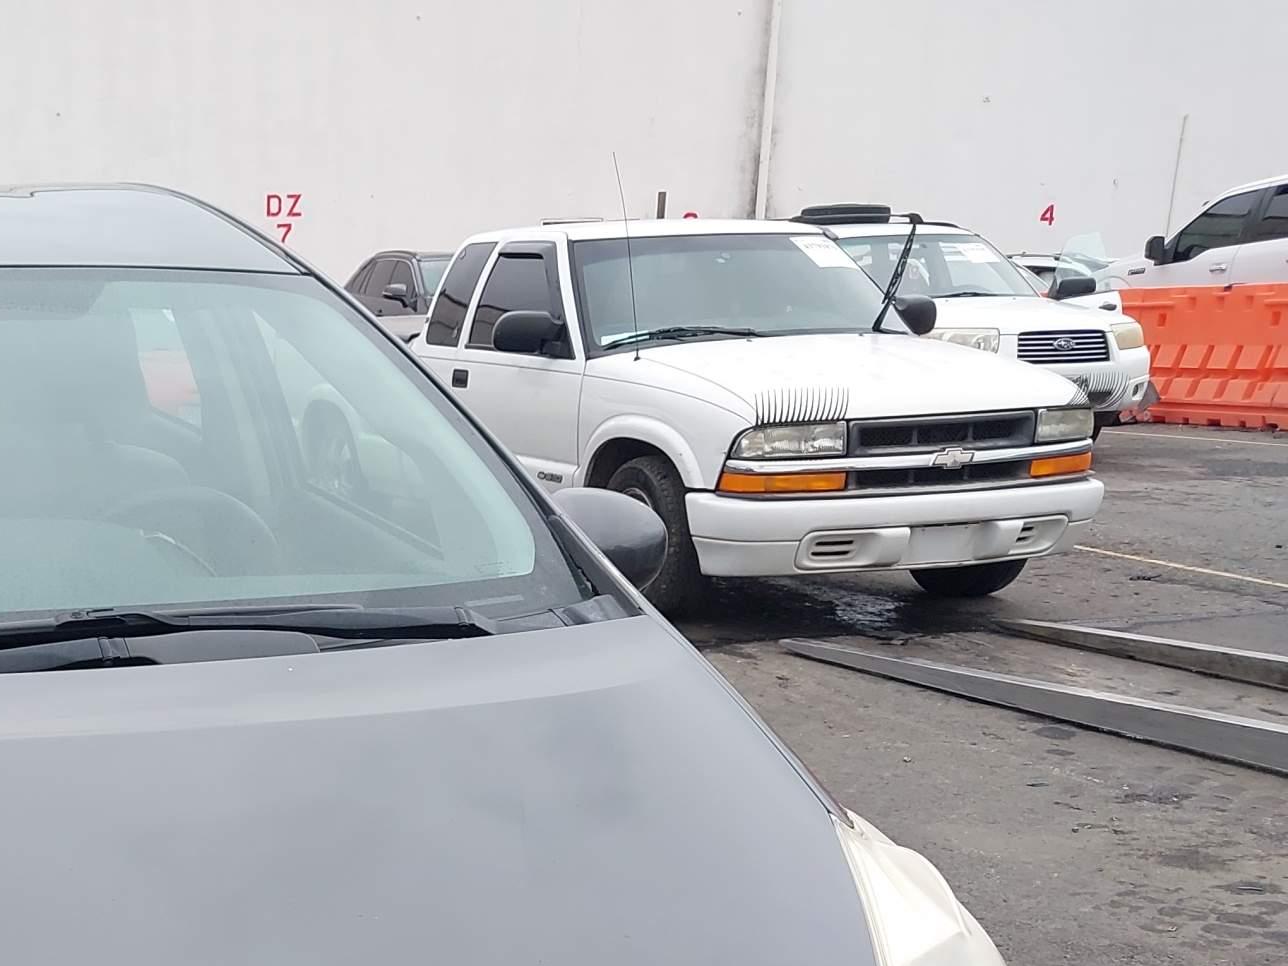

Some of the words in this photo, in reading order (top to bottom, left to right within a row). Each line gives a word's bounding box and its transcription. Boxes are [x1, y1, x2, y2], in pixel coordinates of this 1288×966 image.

[267, 194, 302, 217] DZ
[1040, 204, 1055, 226] 4
[277, 223, 292, 243] 7
